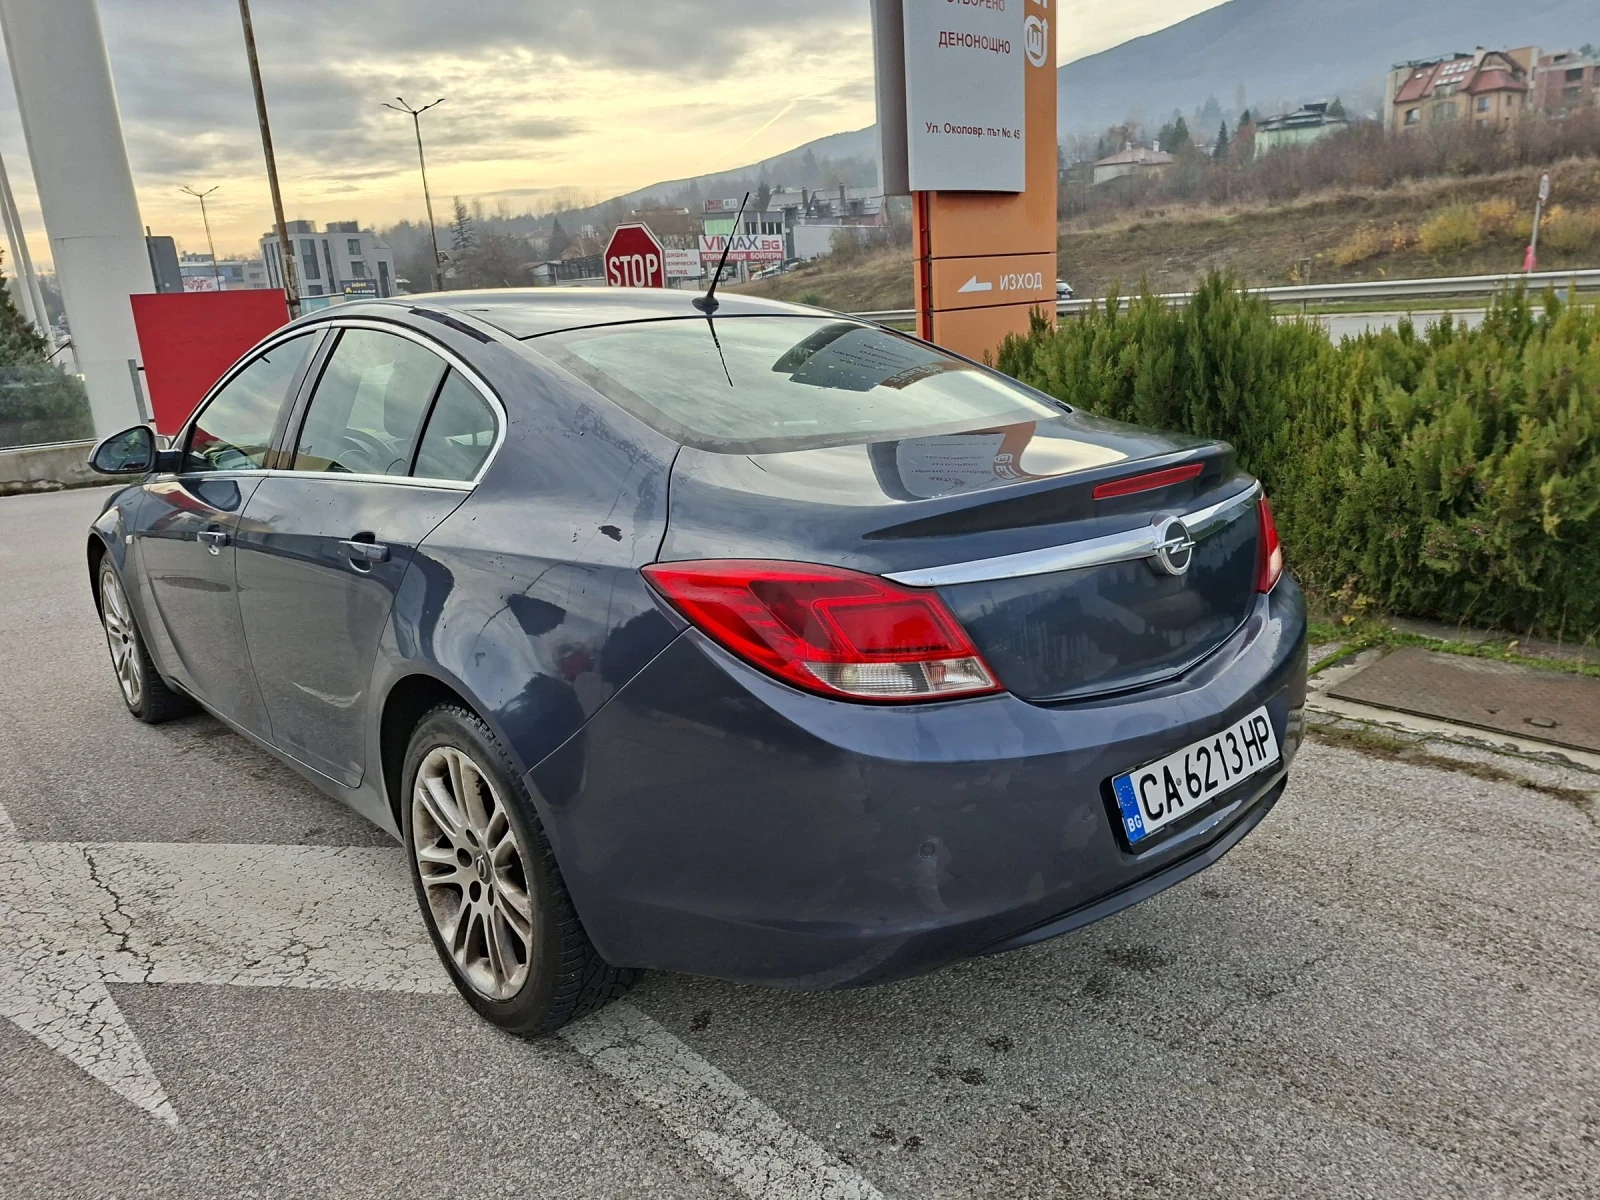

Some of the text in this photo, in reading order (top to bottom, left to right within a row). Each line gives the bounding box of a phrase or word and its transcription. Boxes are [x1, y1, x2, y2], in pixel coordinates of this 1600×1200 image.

[938, 31, 1011, 54] ДЕНОНОЩНО
[925, 122, 1021, 140] Ул. Околовр. път No. 45
[750, 251, 783, 260] БОЙЛЕРИ
[609, 253, 659, 287] STOP
[1000, 272, 1043, 291] ИЗХОД
[1127, 814, 1142, 833] BG
